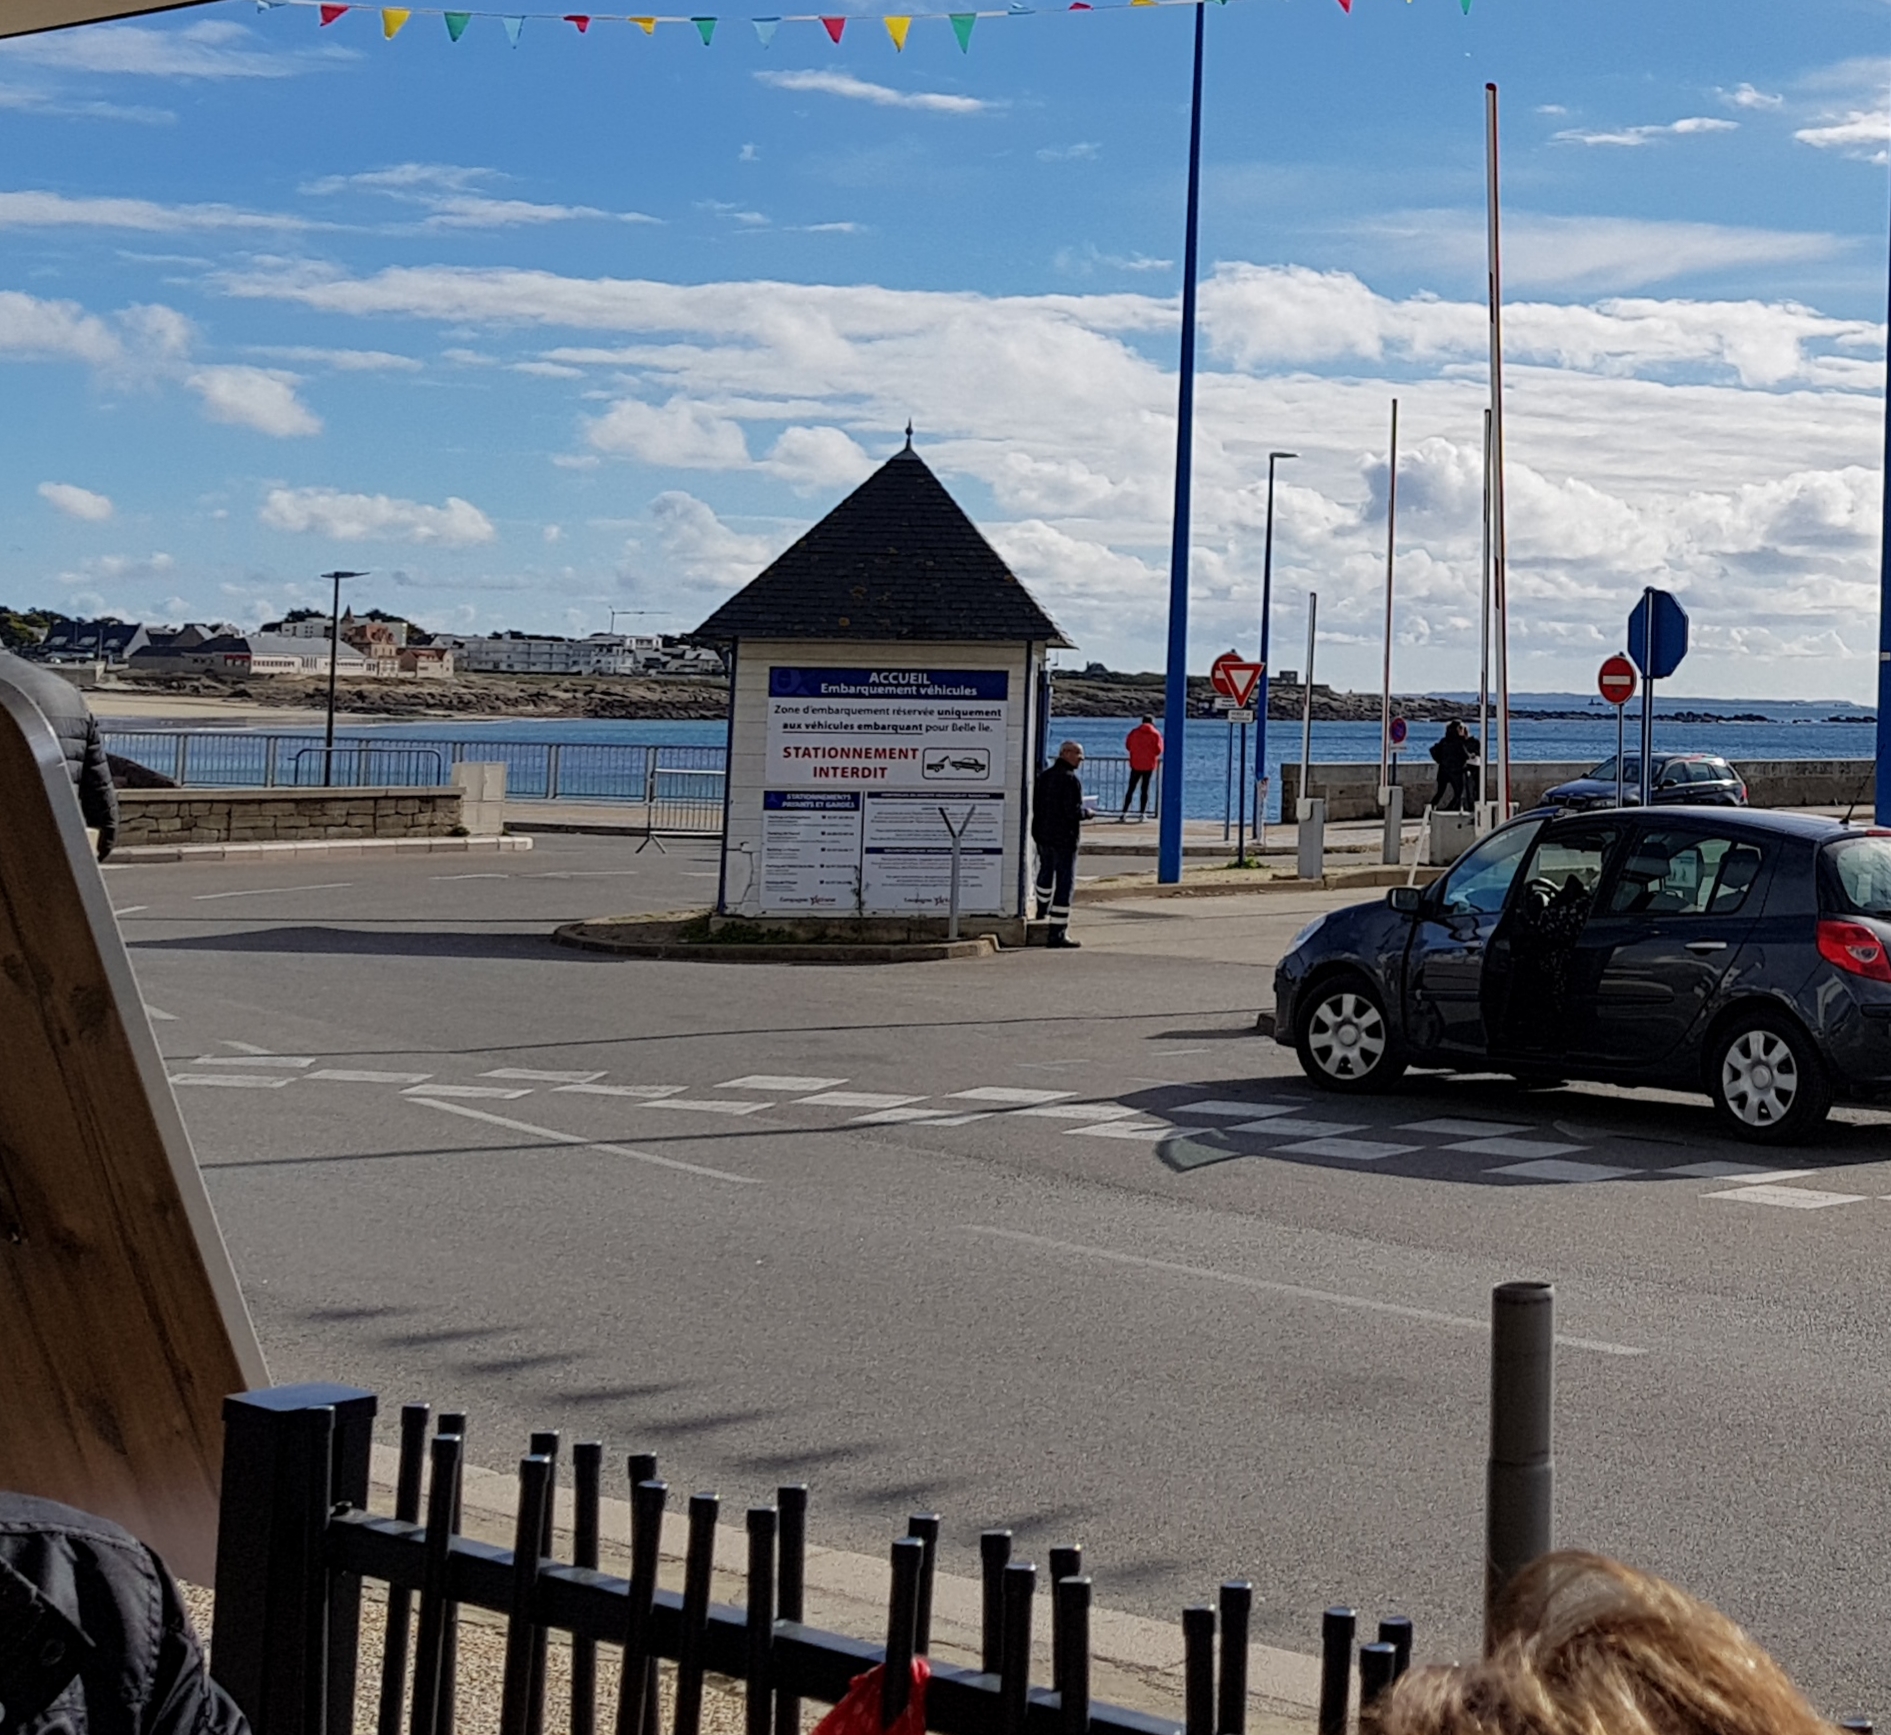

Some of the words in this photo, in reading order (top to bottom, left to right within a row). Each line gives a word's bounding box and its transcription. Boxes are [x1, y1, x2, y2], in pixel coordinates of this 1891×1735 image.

[869, 672, 931, 685] ACCUEIL
[820, 683, 917, 697] Embarquement
[919, 684, 978, 696] véhicules
[774, 705, 800, 715] Zone
[802, 705, 890, 717] d'embarquement
[892, 706, 935, 716] réservée
[937, 707, 1002, 719] uniquement
[782, 722, 802, 731] aux
[804, 721, 855, 731] véhicules
[857, 721, 924, 734] embarquant
[925, 723, 949, 733] pour
[951, 722, 976, 732] Belle
[782, 746, 919, 760] STATIONNEMENT
[813, 766, 888, 779] INTERDIT
